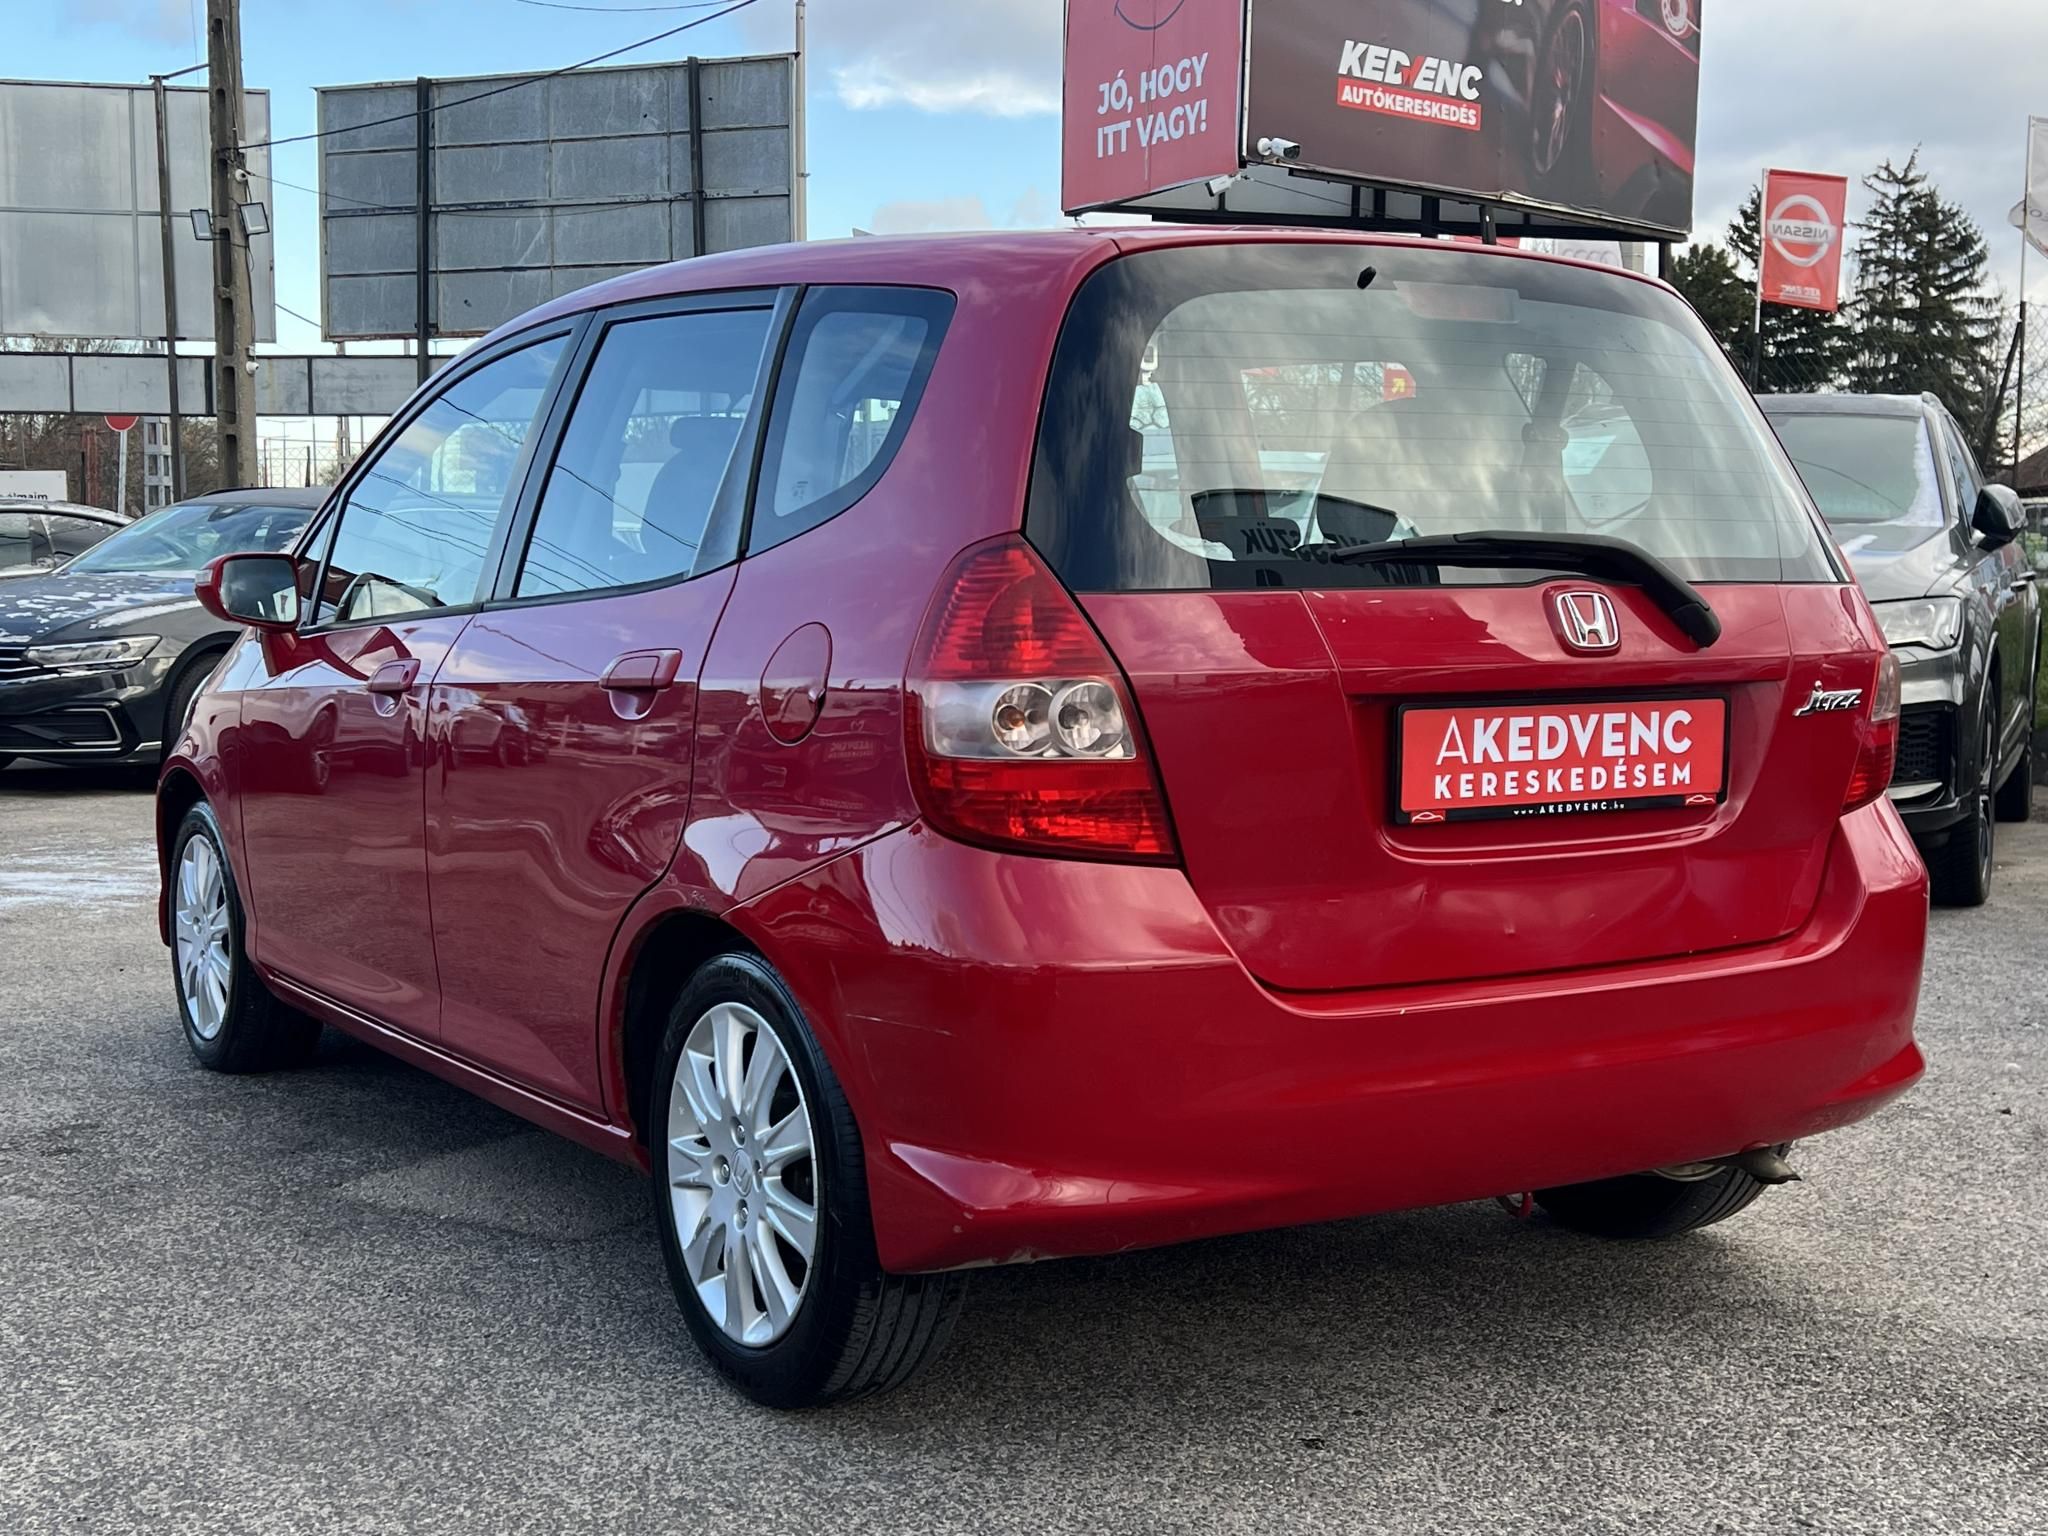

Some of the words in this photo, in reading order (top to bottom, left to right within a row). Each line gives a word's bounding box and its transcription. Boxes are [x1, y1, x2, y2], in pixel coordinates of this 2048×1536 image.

[1097, 69, 1133, 115] JÓ,
[1140, 52, 1208, 103] HOGY
[1341, 85, 1477, 125] AUTÓKERESKEDÉS
[1097, 120, 1131, 158] ITT
[1136, 98, 1207, 147] VAGY!
[1436, 709, 1692, 765] AKEDVENC
[1435, 757, 1691, 800] KERESKEDÉSEM
